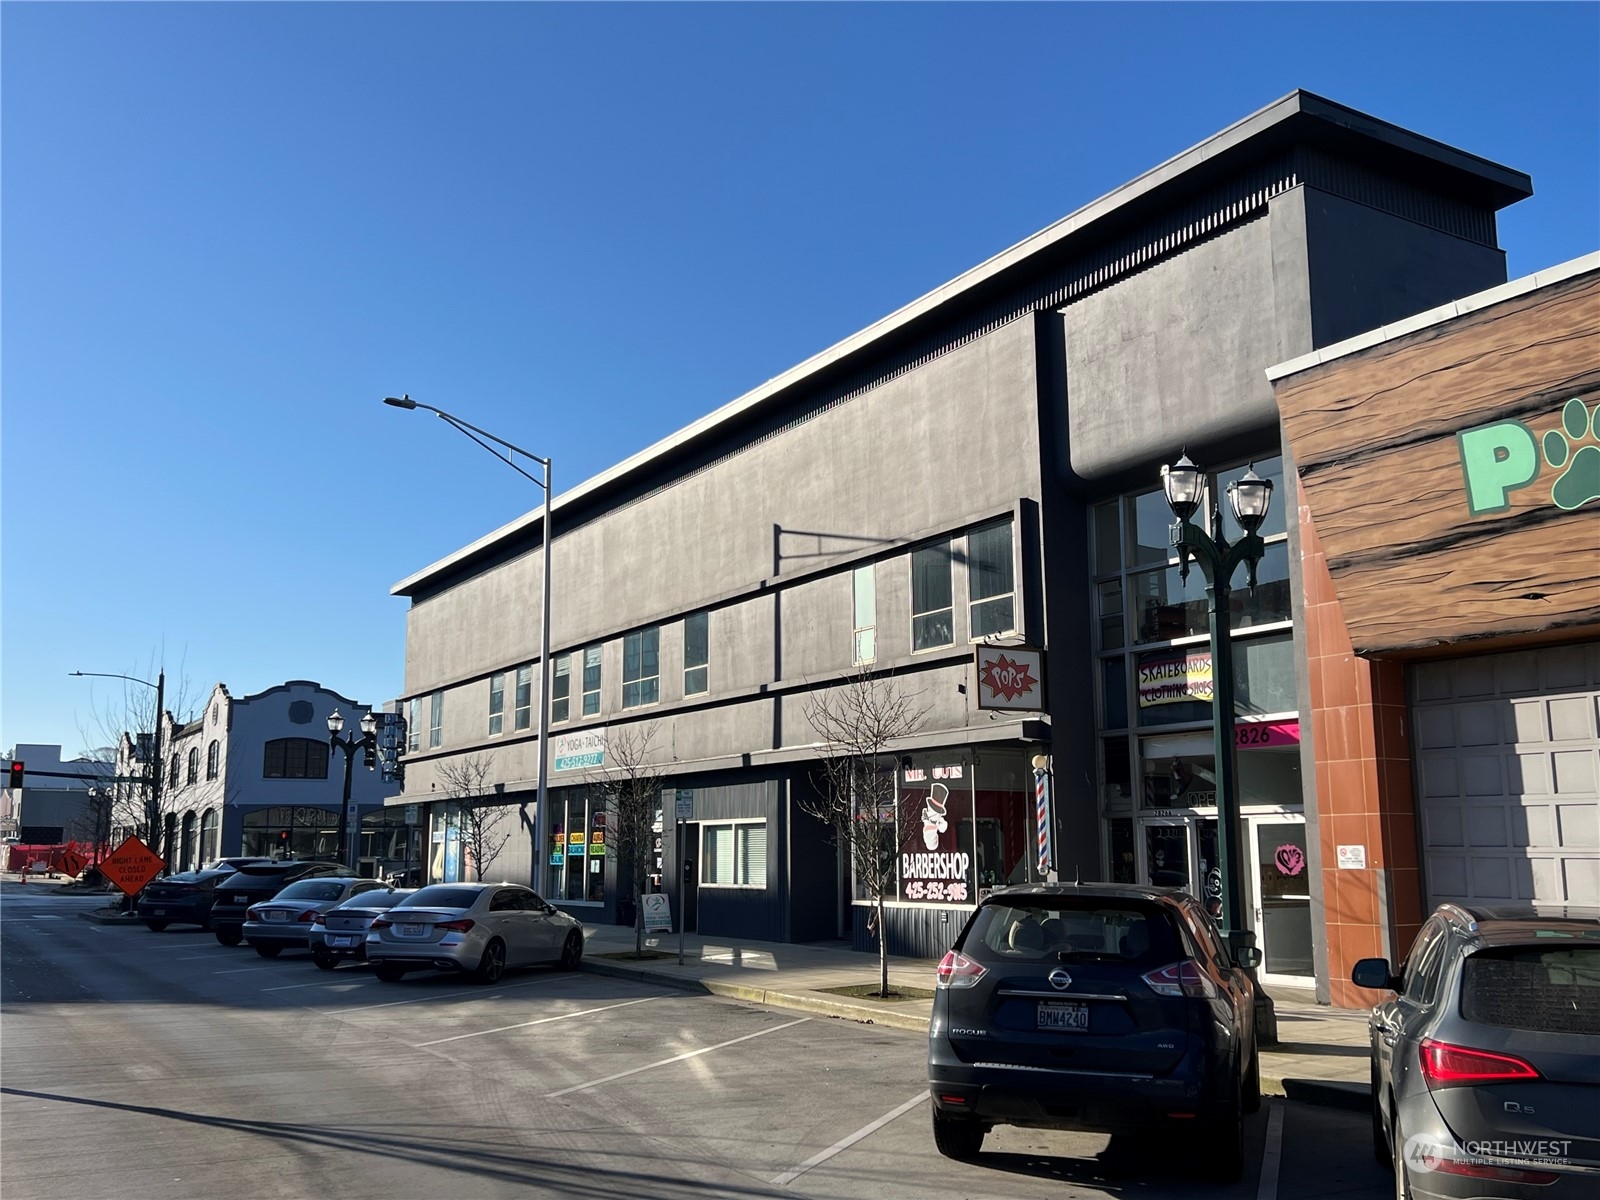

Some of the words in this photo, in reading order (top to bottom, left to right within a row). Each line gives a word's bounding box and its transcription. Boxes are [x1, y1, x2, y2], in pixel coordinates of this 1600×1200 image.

[991, 666, 1025, 689] POPS
[1141, 657, 1212, 684] SKATEBOARDS
[1145, 683, 1187, 702] CLOTHING
[1188, 680, 1213, 697] SHOES
[567, 739, 582, 751] YOGA
[1189, 791, 1216, 807] OPE
[902, 852, 969, 880] BARBERSHOP
[119, 875, 144, 883] AHEAD
[1039, 1011, 1087, 1026] BMW4240
[952, 1027, 987, 1036] ROGUE
[1504, 1101, 1536, 1114] Q5
